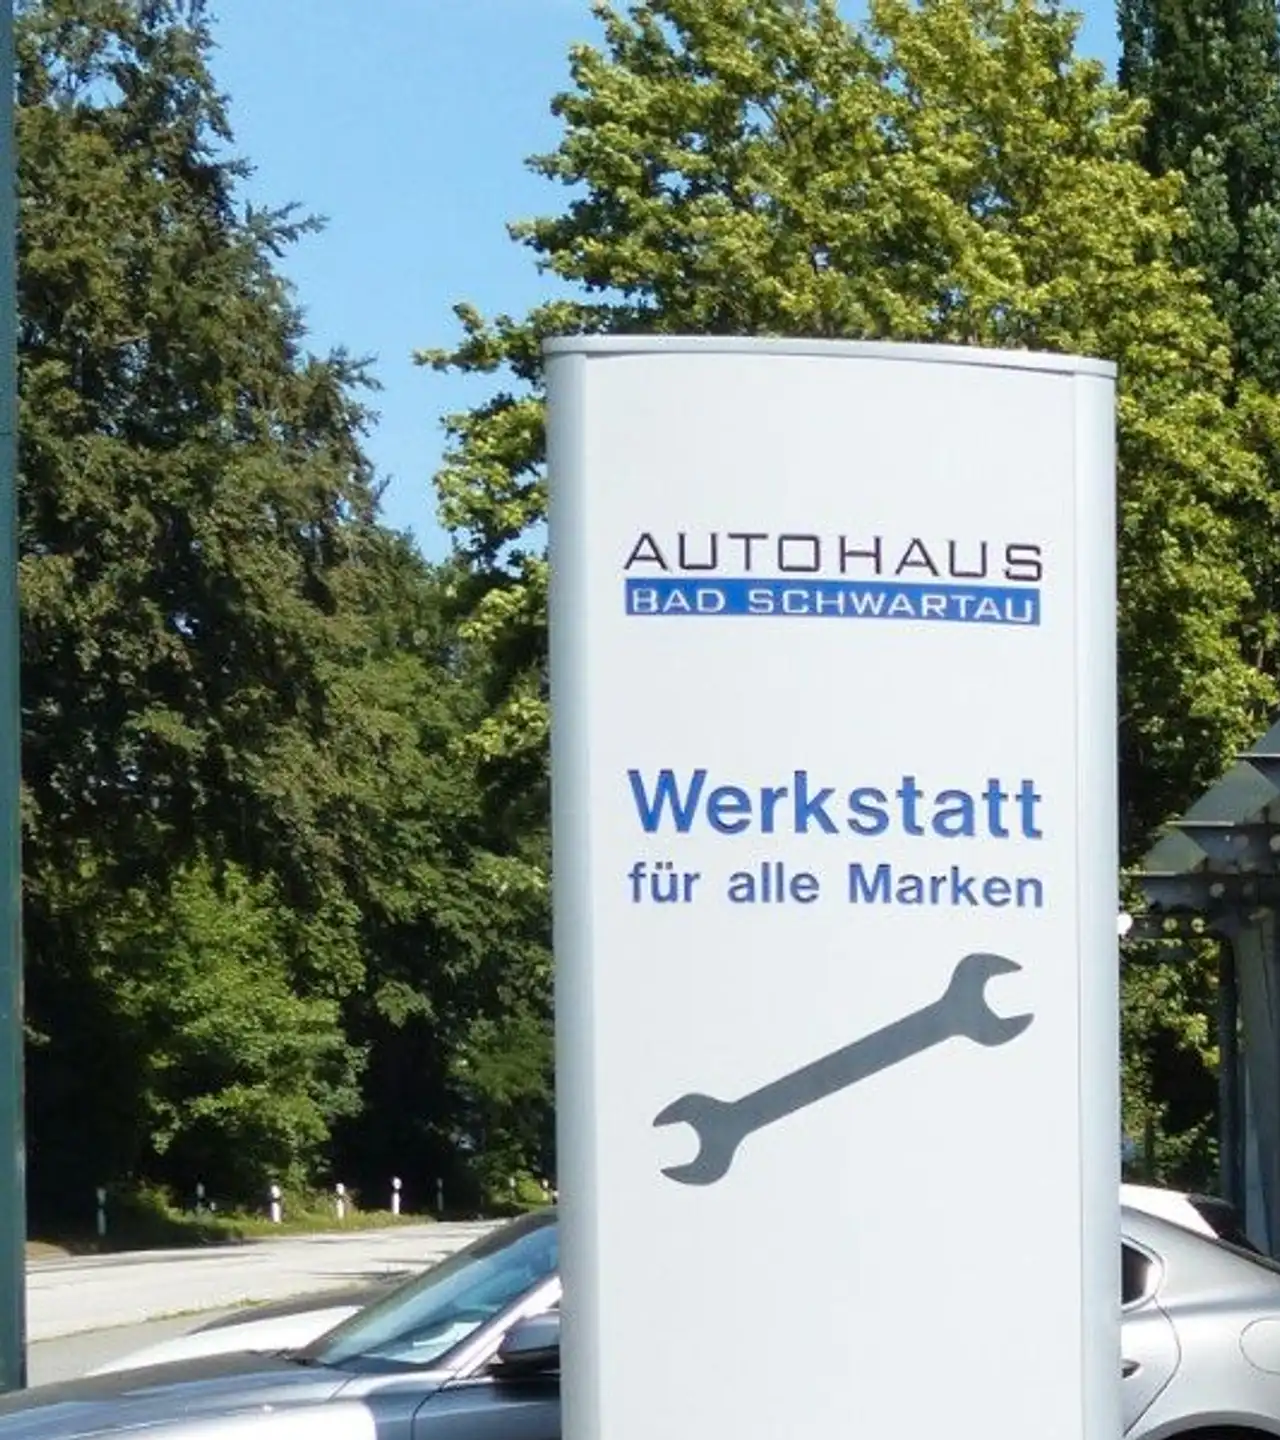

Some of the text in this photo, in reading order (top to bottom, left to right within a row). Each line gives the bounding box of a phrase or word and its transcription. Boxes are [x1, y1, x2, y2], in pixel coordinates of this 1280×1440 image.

[623, 532, 1043, 582] AUTOHAUS
[632, 588, 1034, 623] BAD SCHWARTAU
[627, 768, 1044, 839] Werkstatt
[627, 861, 1043, 907] für alle Marken
